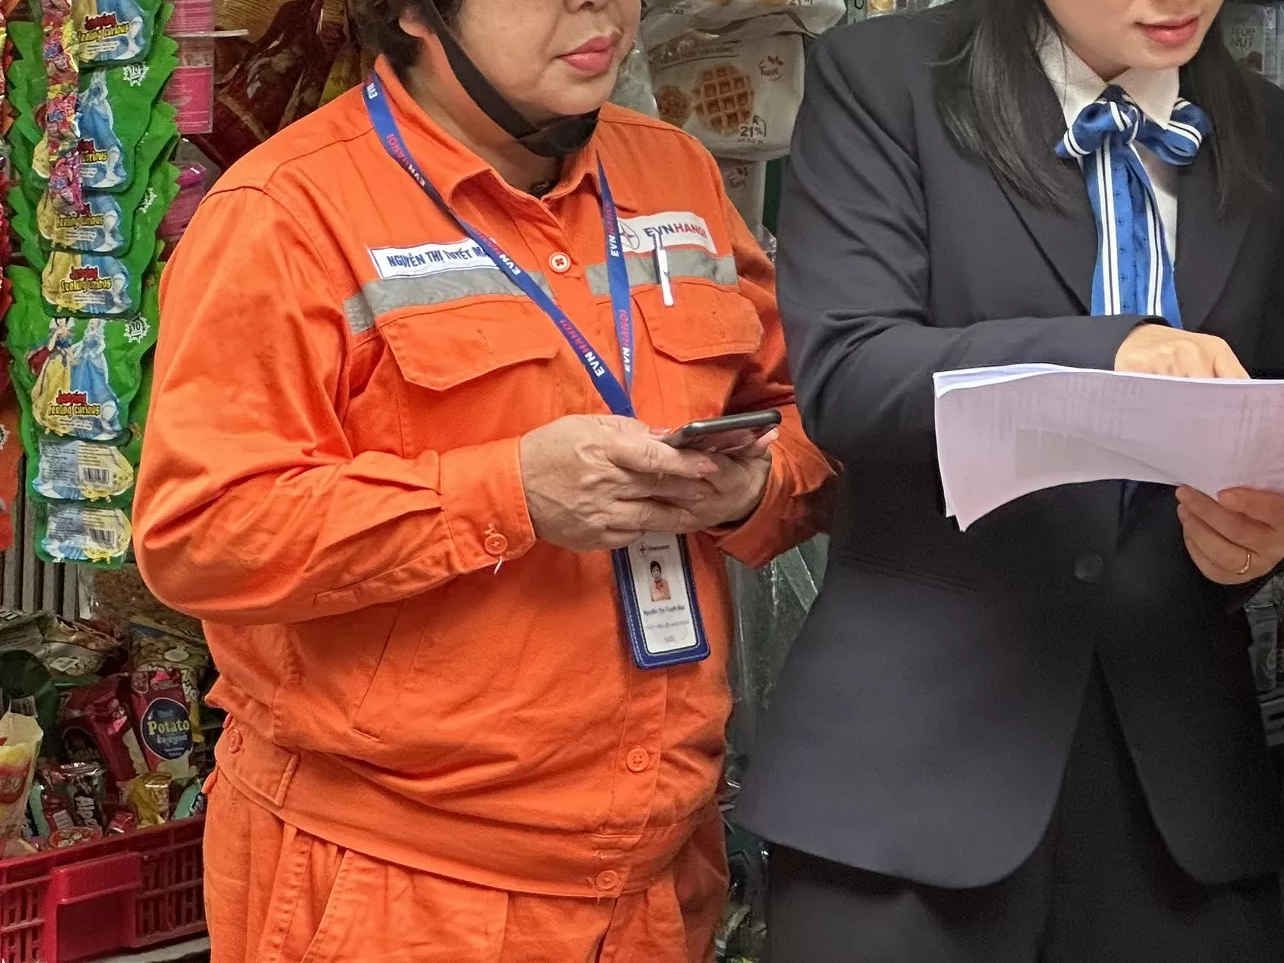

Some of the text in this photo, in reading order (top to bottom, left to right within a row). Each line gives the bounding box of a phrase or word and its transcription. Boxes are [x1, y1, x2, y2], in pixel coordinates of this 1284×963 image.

[386, 252, 426, 268] NGUYỄN
[427, 249, 445, 264] THỊ
[475, 246, 489, 258] MA
[559, 318, 606, 378] EVNHANOI
[617, 309, 633, 373] EVNHANOI
[148, 719, 190, 735] Potato
